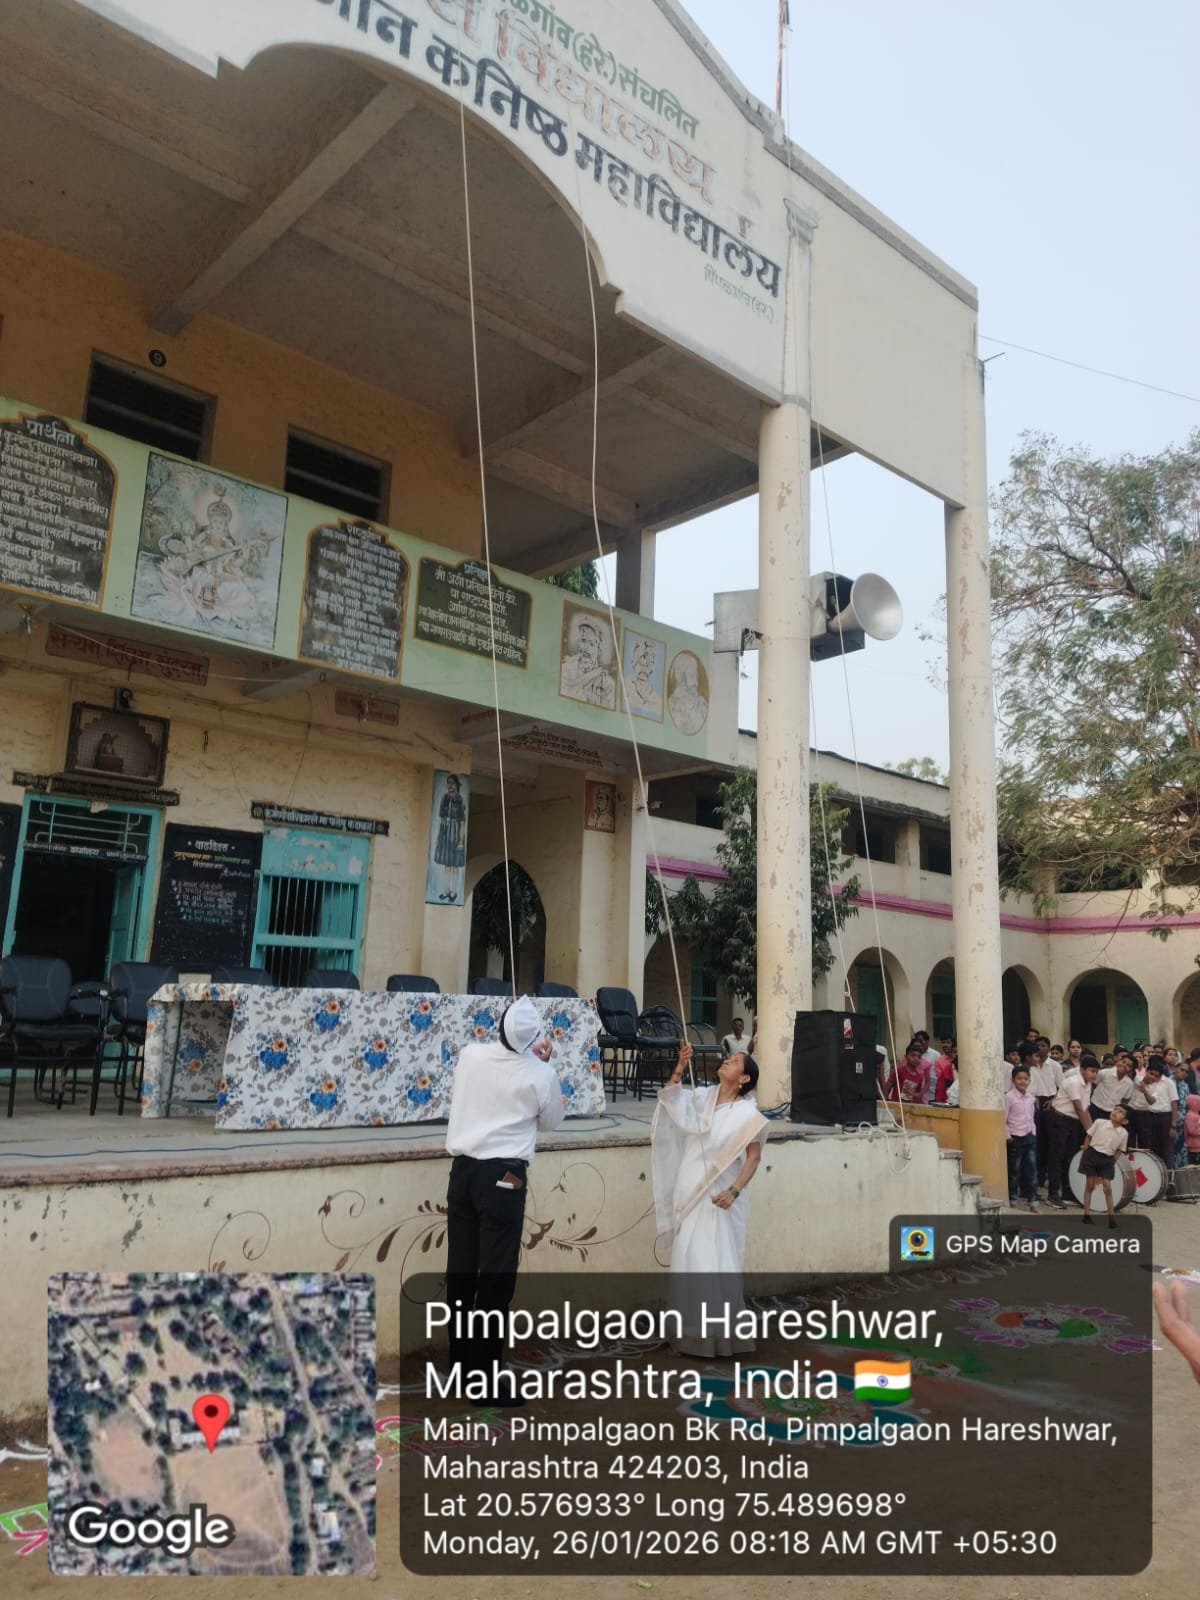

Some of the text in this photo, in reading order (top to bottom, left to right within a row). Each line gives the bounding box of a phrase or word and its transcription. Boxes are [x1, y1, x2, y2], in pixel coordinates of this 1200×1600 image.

[426, 34, 569, 157] कनिष्ठ
[574, 132, 782, 298] महाविद्यालय
[26, 420, 76, 447] प्रार्थना
